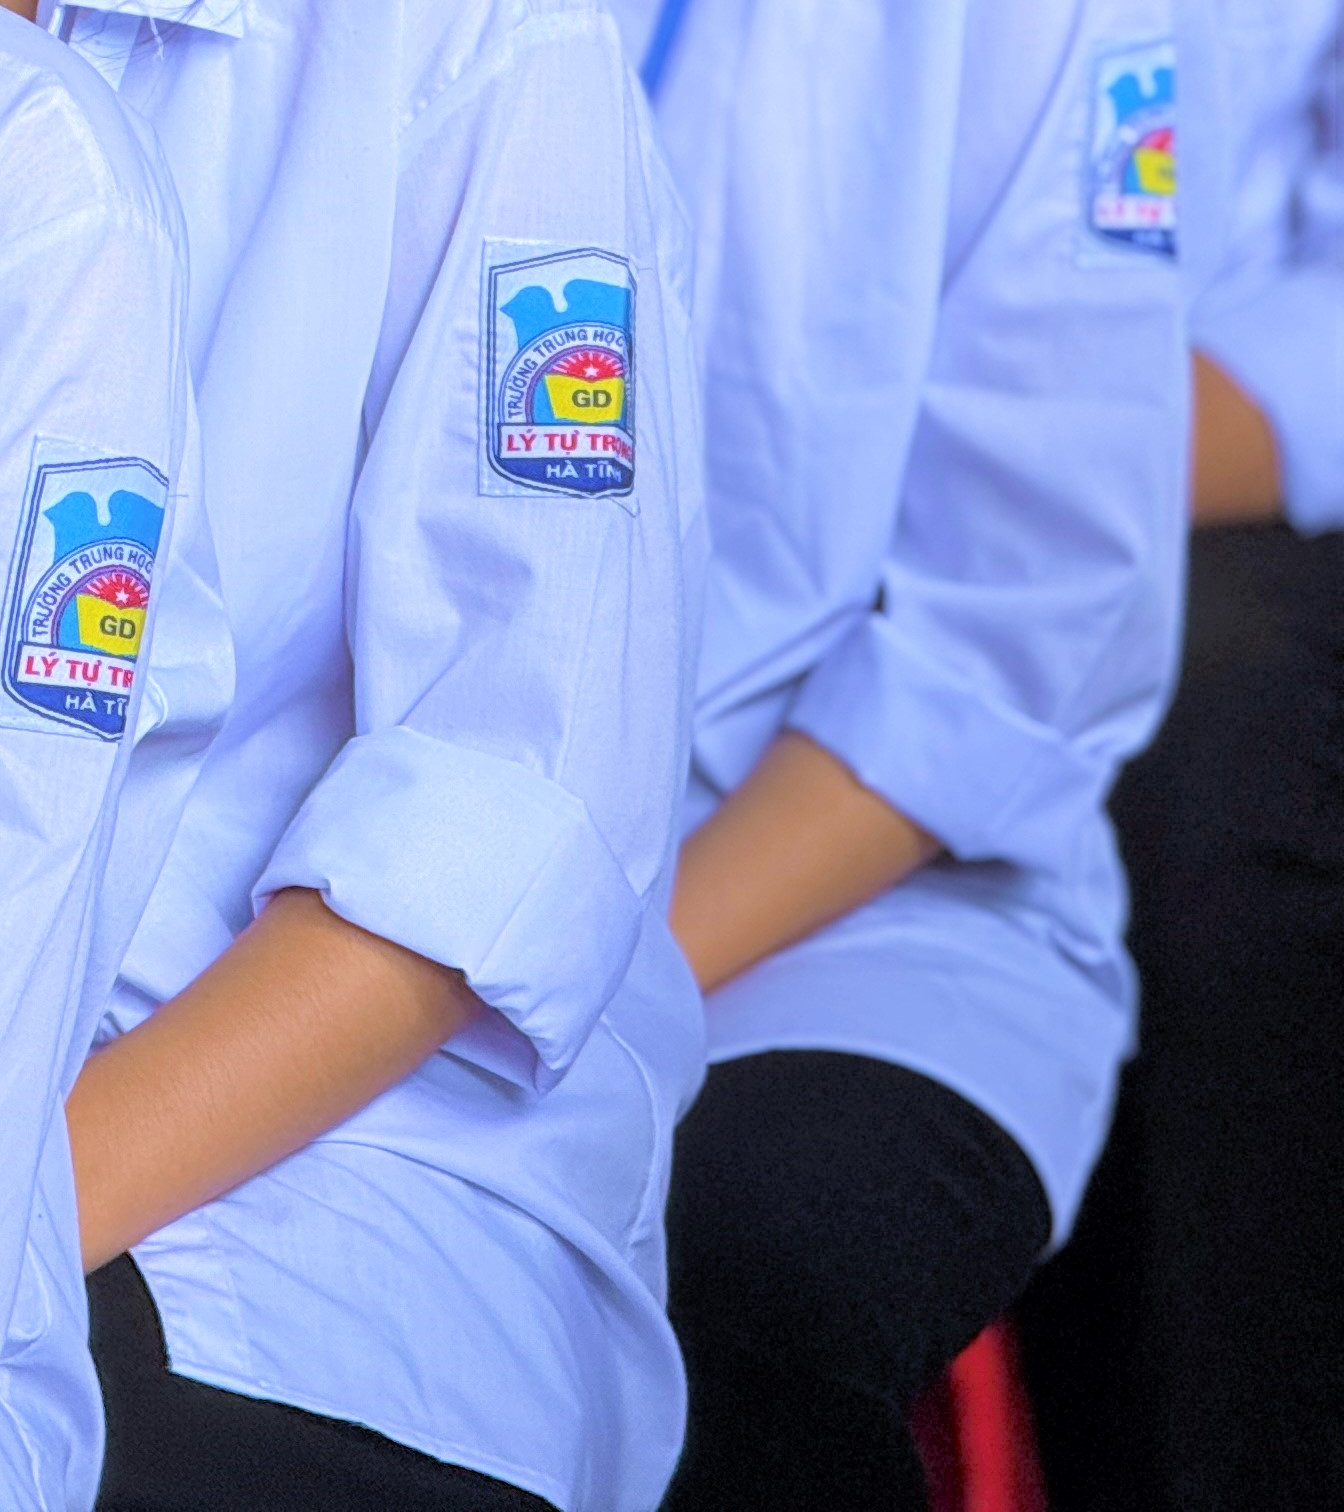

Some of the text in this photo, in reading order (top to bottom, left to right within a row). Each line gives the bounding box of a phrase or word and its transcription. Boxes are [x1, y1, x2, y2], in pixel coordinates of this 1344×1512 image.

[533, 329, 589, 358] TRUNG
[592, 329, 625, 348] HỌC
[572, 389, 612, 408] GD
[506, 428, 537, 452] LÝ
[543, 429, 580, 455] TỰ
[546, 459, 579, 479] HÀ
[69, 547, 124, 575] TRUNG
[99, 615, 136, 639] GD
[25, 652, 60, 677] LÝ
[66, 660, 103, 686] TỰ
[65, 691, 127, 716] HÀ TĨ
